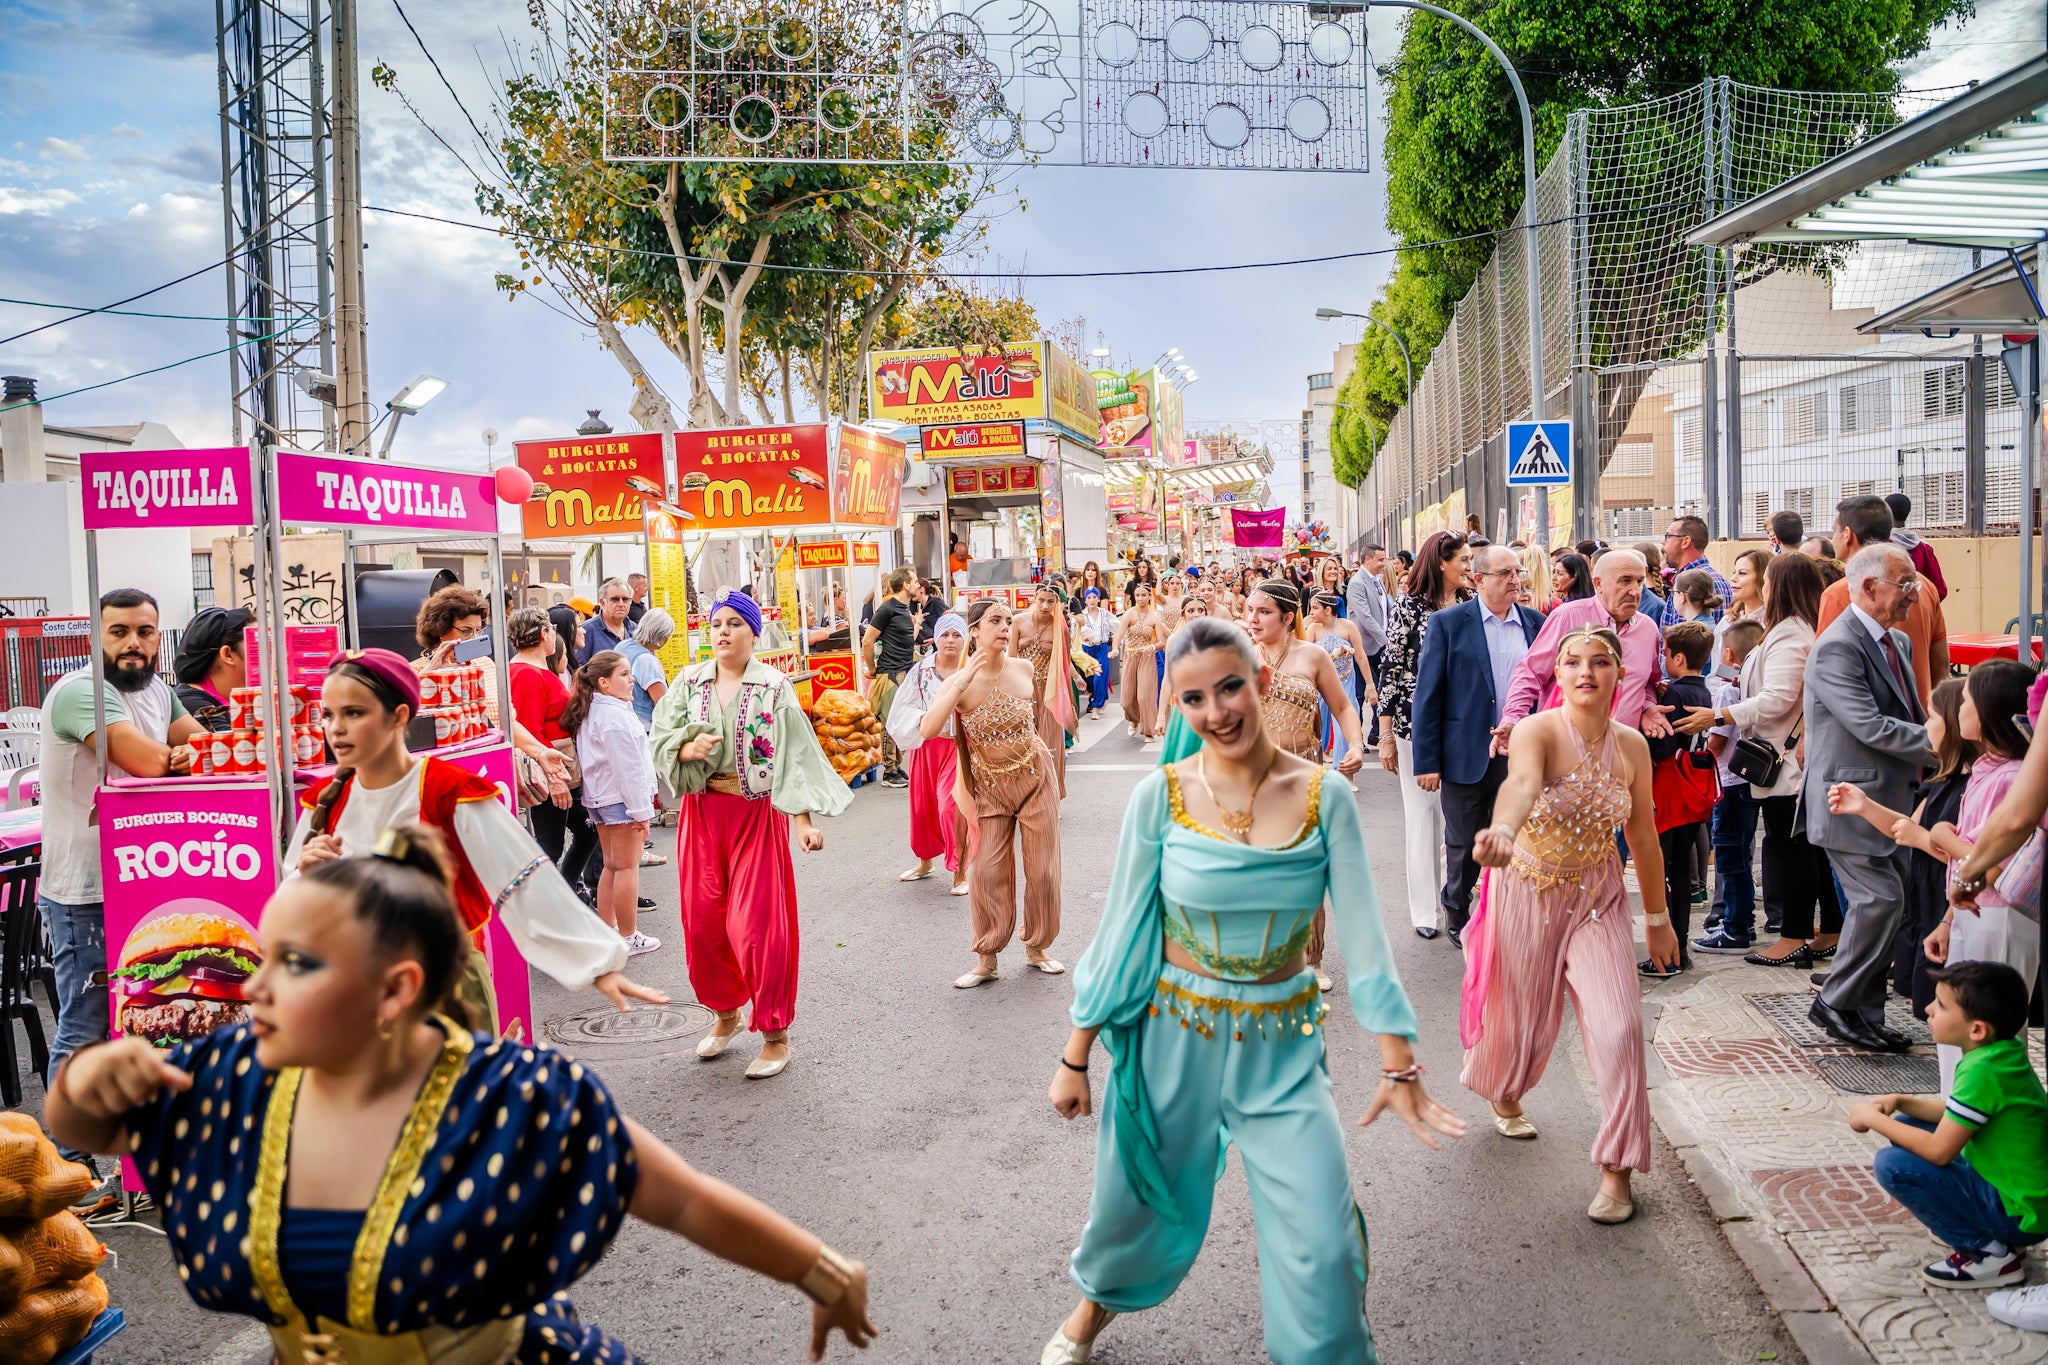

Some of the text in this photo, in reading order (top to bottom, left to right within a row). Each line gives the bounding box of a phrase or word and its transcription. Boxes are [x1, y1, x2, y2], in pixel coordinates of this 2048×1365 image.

[1001, 347, 1034, 357] SADAS
[906, 362, 1010, 405] Malú
[914, 402, 1003, 415] PATATAS ASADAS
[931, 413, 963, 424] KEBAB
[974, 410, 1021, 421] BOCATAS
[930, 428, 978, 448] Malú
[980, 426, 1012, 436] BURGUER
[989, 434, 1018, 445] BOCATAS
[706, 432, 793, 448] BURGUER
[547, 442, 630, 459] BURGUER
[701, 449, 801, 466] & BOCATAS
[542, 458, 638, 476] & BOCATAS
[93, 467, 238, 517] TAQUILLA
[848, 456, 887, 516] Malú
[316, 471, 467, 521] TAQUILLA
[703, 478, 805, 518] Malú
[545, 488, 643, 528] Malú
[802, 546, 843, 564] TAQUILLA
[855, 546, 878, 562] TAQUILLA
[43, 623, 65, 632] Costa
[819, 667, 846, 682] Malú
[112, 811, 258, 830] BURGUER BOCATAS
[113, 829, 262, 883] ROCÍO
